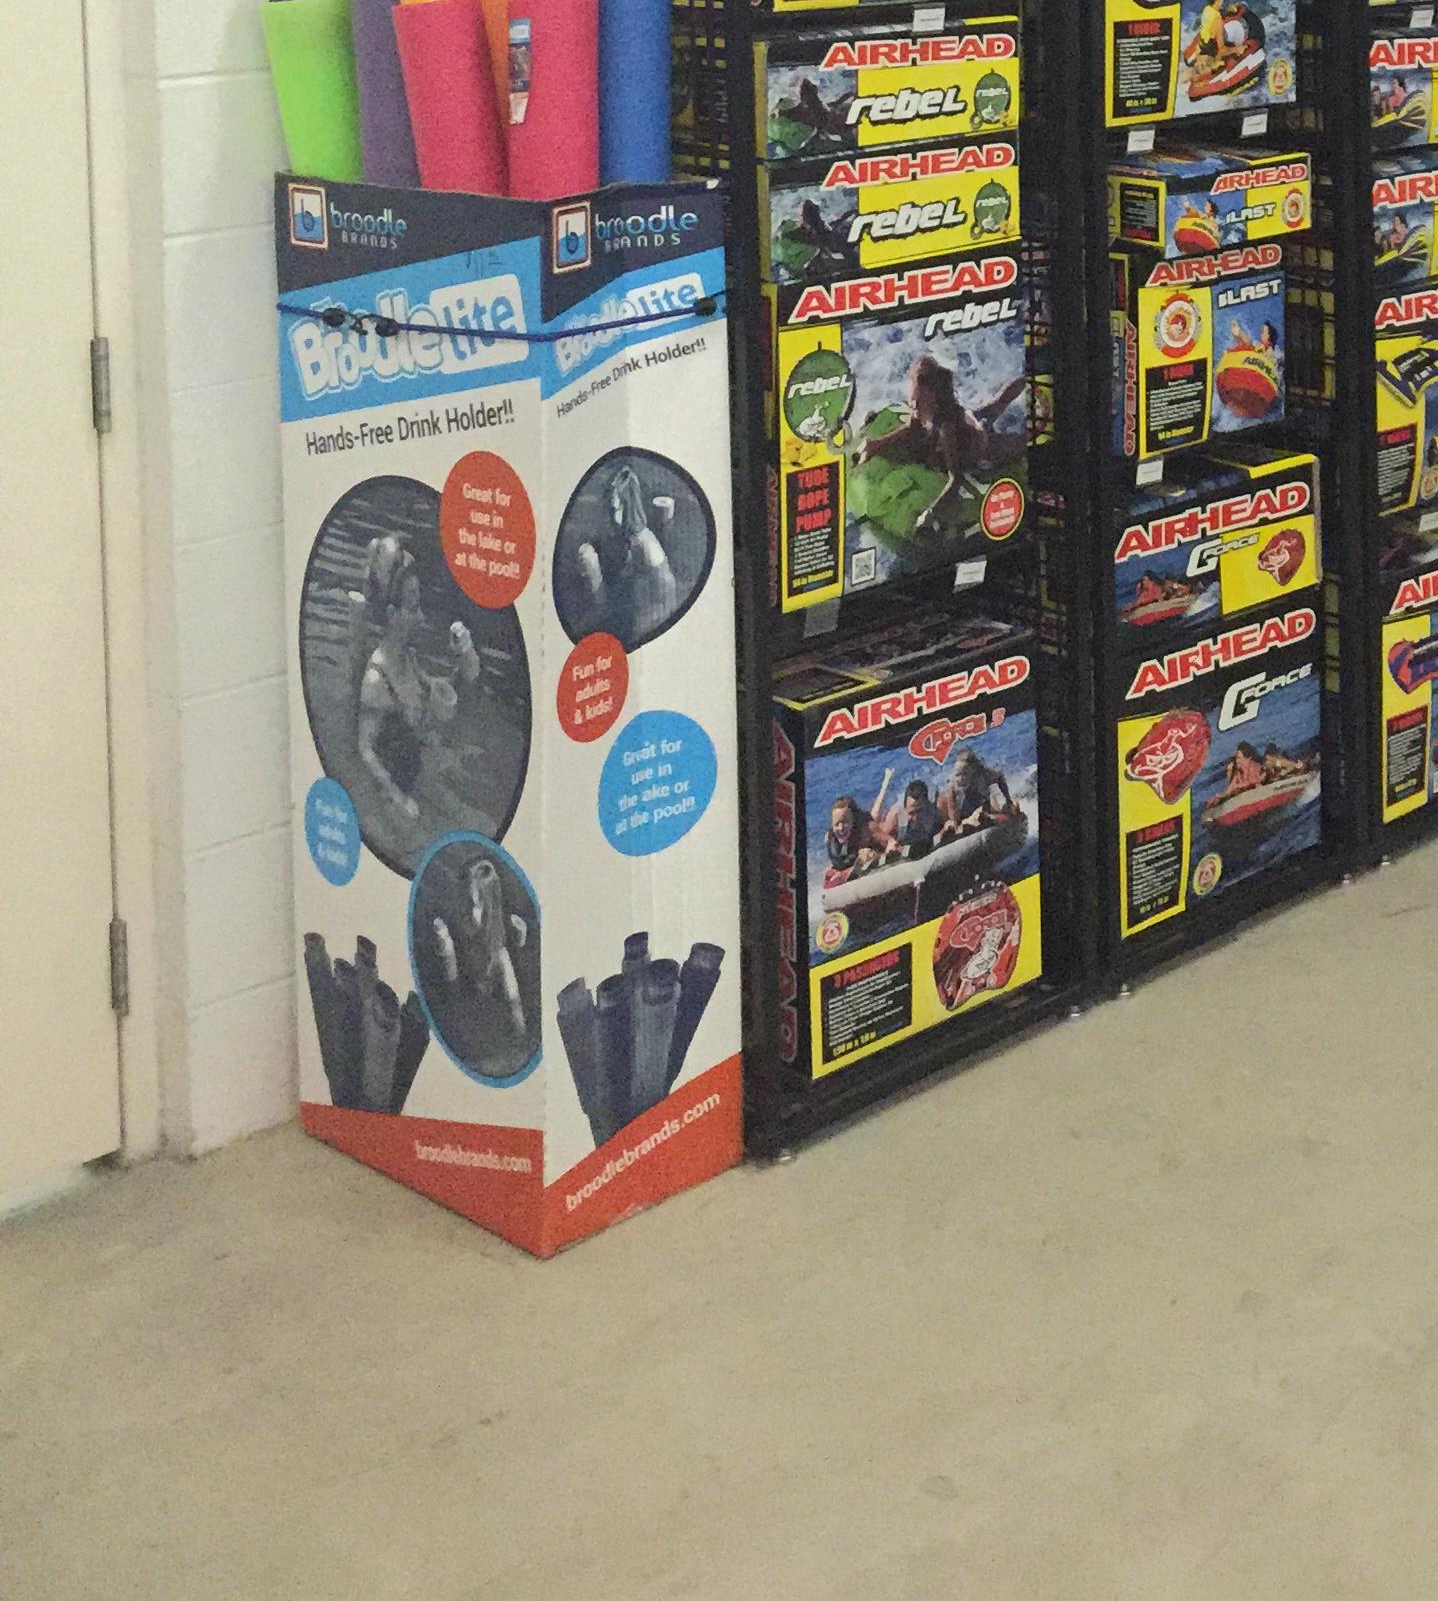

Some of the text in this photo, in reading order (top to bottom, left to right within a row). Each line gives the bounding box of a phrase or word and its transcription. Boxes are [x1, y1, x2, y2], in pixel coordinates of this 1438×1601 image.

[819, 34, 1017, 71] AIRHEAD
[844, 84, 969, 126] rebel
[820, 142, 1015, 191] AIRHEAD
[1211, 162, 1308, 195] AIRHEAD
[846, 197, 969, 244] rebel
[1146, 244, 1282, 287] AIRHEAD
[788, 256, 1019, 324] AIRHEAD
[923, 298, 1021, 340] rebel
[305, 423, 394, 456] Hands-Free
[397, 417, 442, 442] Drink
[462, 483, 511, 507] Great for
[1114, 480, 1311, 564] AIRHEAD
[1125, 607, 1317, 701] AIRHEAD
[813, 655, 1031, 749] AIRHEAD
